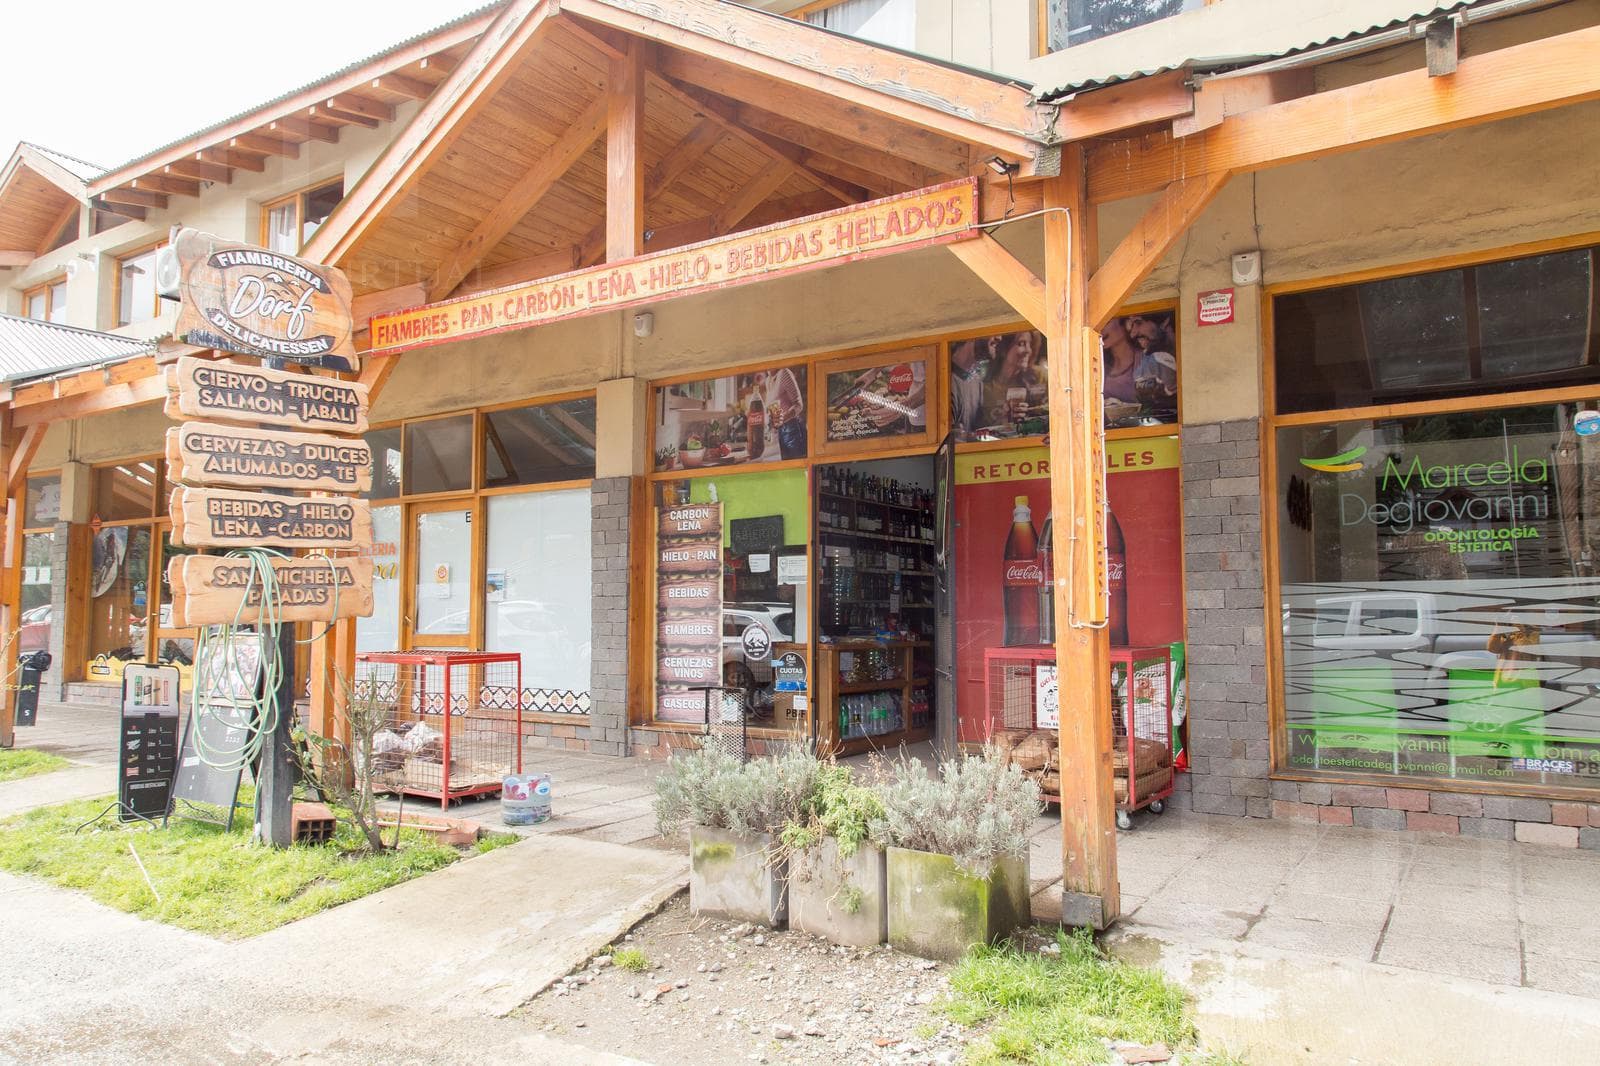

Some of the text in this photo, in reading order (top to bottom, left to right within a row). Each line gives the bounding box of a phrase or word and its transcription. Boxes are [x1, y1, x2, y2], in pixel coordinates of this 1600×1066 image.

[216, 251, 321, 290] FIAMBRERIA
[376, 312, 450, 345] FIAMBRES
[460, 302, 494, 329] PAN
[502, 283, 576, 321] CARBÓN
[587, 269, 637, 303] LEÑA
[649, 253, 711, 291] HIELO
[726, 228, 823, 274] BEBIDAS
[835, 195, 963, 250] HELADOS
[228, 273, 314, 340] Dorf
[210, 312, 329, 355] DELICATESSEN
[194, 368, 267, 392] CIERVO
[287, 382, 358, 406] TRUCHA
[200, 389, 284, 414] SALMON
[302, 403, 355, 422] JABALI
[186, 435, 286, 458] CERVEZAS
[305, 445, 369, 465] DULCES
[206, 456, 317, 479] AHUMADOS
[336, 465, 355, 481] TE
[973, 450, 1155, 479] RETORLES
[1381, 444, 1548, 491] Marcela
[208, 500, 283, 519] BEBIDAS
[302, 504, 354, 521] HIELO
[669, 508, 709, 520] CARBON
[1340, 485, 1549, 534] Degiovanni
[212, 514, 263, 537] LEÑA
[1423, 525, 1539, 542] ODONTOLOGÍA
[662, 551, 689, 562] HIELO
[697, 550, 717, 560] PAN
[247, 588, 327, 605] PCADAS
[668, 587, 710, 598] BEBIDAS
[665, 624, 713, 635] FIAMBRES
[664, 657, 714, 668] CERVEZAS
[674, 668, 704, 678] VINOS
[663, 698, 713, 710] GASEOSA
[1291, 753, 1514, 777] odotoesteticadegovanni@mail.com
[1526, 758, 1573, 769] BRACES
